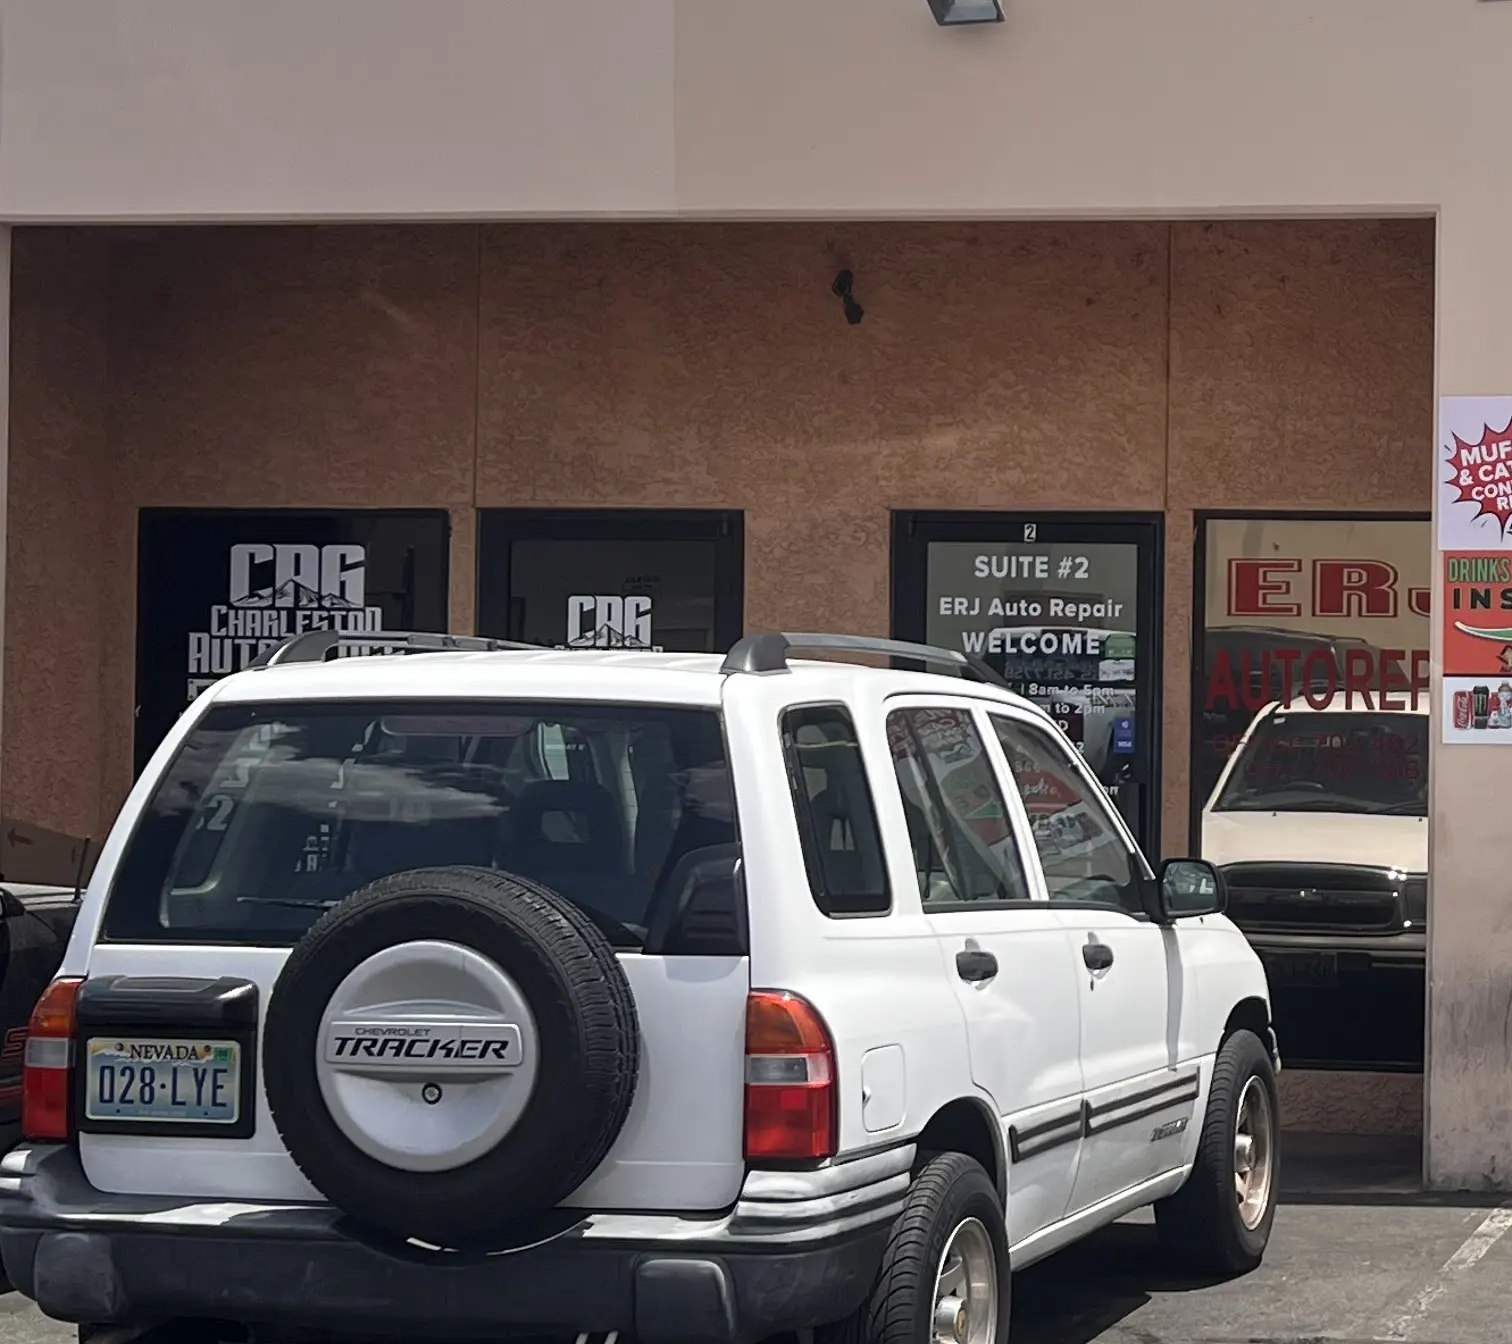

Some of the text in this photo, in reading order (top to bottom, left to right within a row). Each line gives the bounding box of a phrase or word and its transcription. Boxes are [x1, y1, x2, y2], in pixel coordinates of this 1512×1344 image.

[1459, 469, 1474, 486] &
[1025, 525, 1036, 541] 2
[974, 555, 1089, 578] SUITE #2
[1448, 557, 1511, 583] DRINKS
[939, 597, 1123, 621] ERJ Auto Repair
[962, 632, 1100, 654] WELCOME
[1028, 683, 1058, 695] 8am
[1064, 685, 1077, 695] to
[1055, 704, 1070, 714] to
[1074, 704, 1105, 716] 2pm
[355, 1028, 430, 1036] CHEVROLET
[130, 1044, 199, 1060] NEVADA
[333, 1036, 509, 1060] TRACKER
